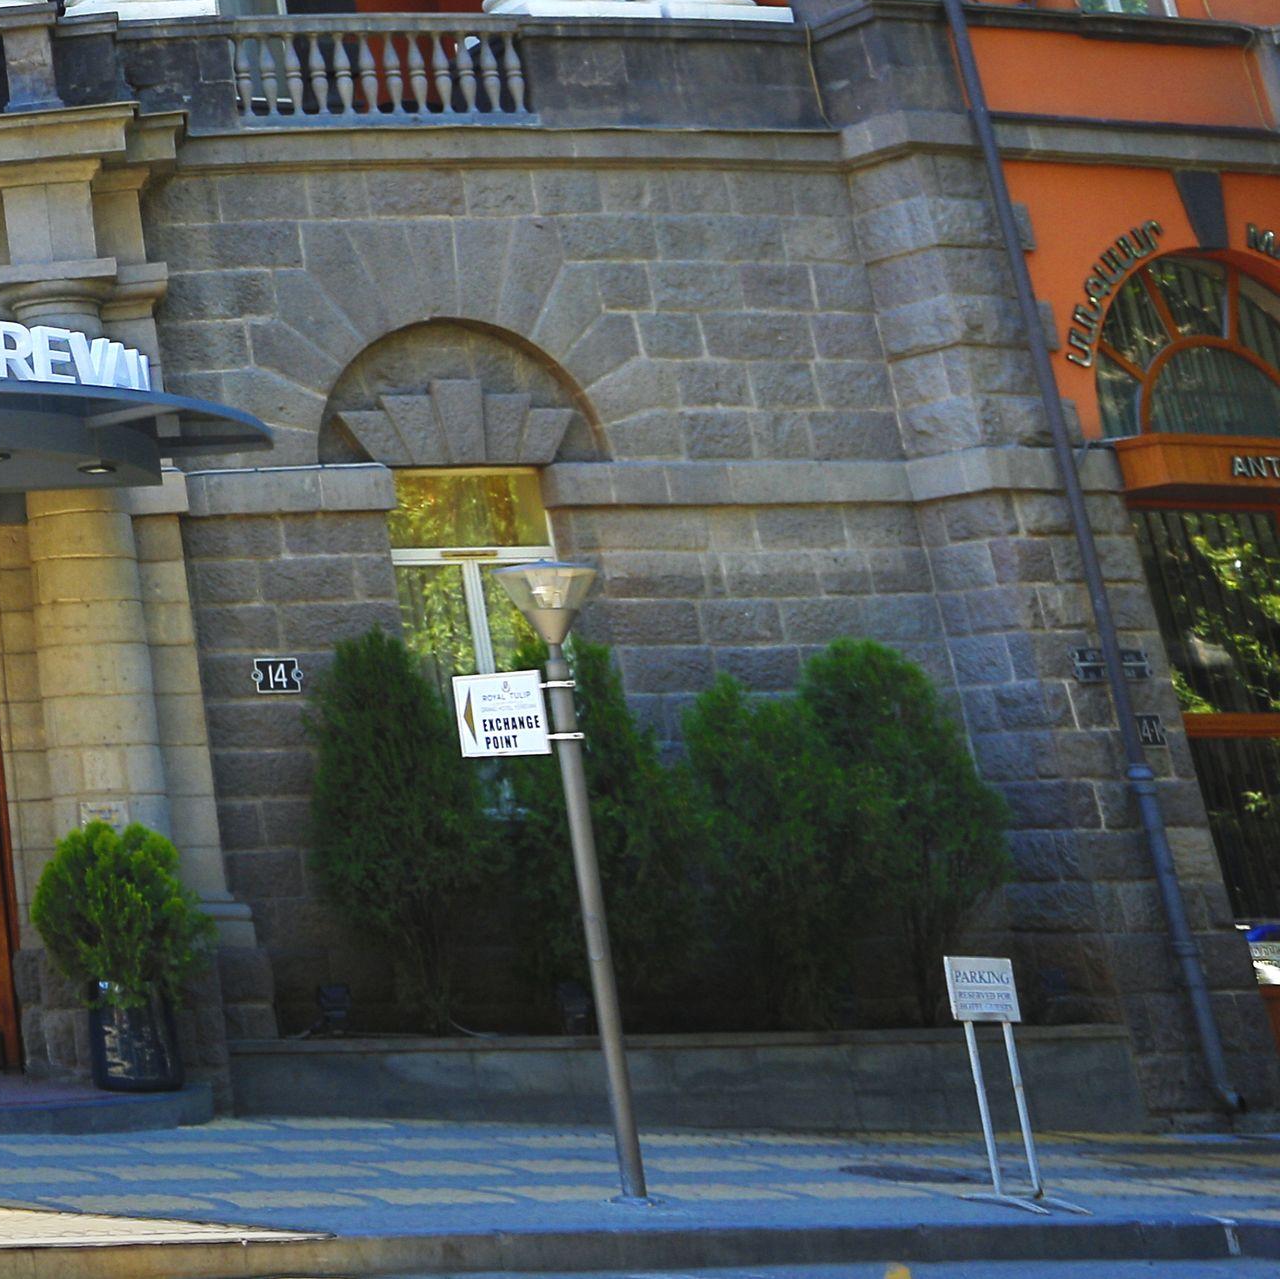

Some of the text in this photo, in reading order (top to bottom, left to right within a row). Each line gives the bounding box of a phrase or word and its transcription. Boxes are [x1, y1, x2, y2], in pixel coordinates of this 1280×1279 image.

[1247, 223, 1280, 260] M
[267, 663, 288, 689] 14
[481, 690, 531, 702] ROYAL TULIP
[482, 715, 541, 732] EXCHANGE
[485, 735, 519, 750] POINT
[954, 970, 1010, 985] PARKING
